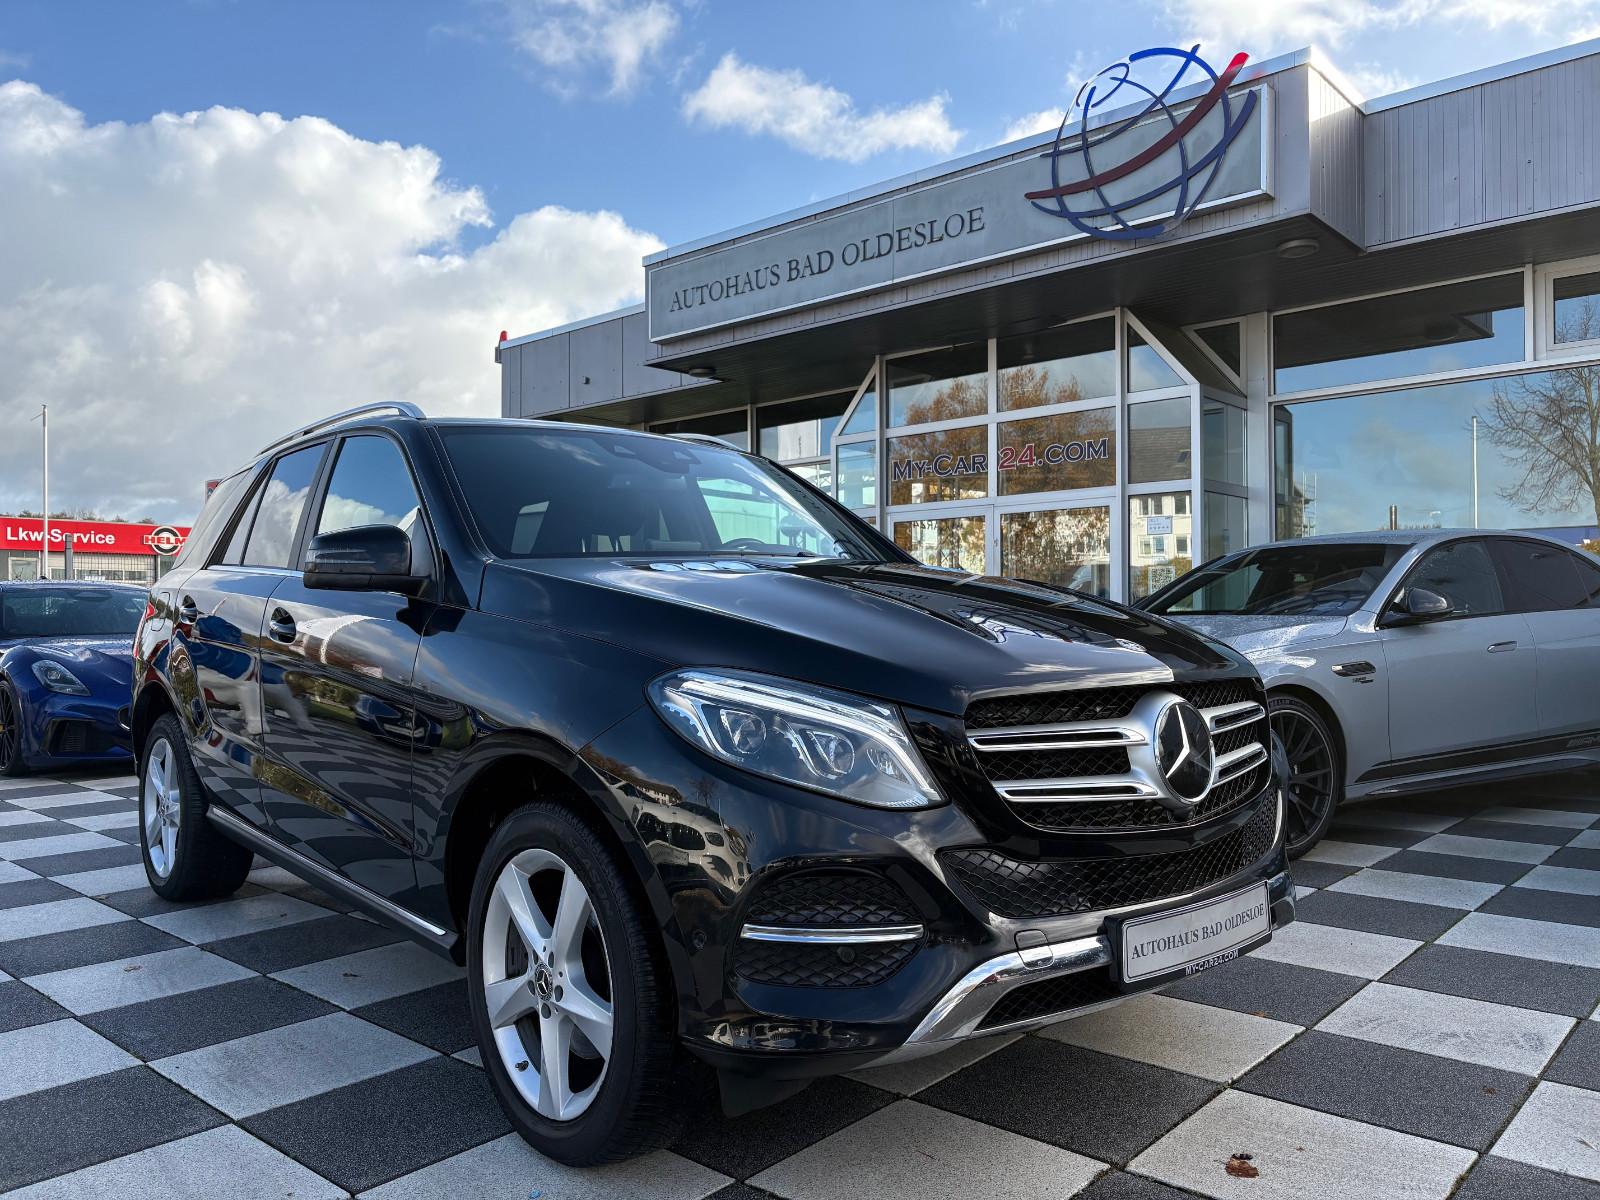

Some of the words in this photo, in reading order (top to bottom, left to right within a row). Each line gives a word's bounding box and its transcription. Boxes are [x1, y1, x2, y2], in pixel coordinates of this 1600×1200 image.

[669, 263, 780, 312] AUTOHAUS
[786, 249, 835, 282] BAD
[841, 206, 985, 267] OLDESLOE
[1131, 929, 1199, 960] AUTOHAUS
[1201, 923, 1223, 940] BAD
[1224, 903, 1265, 931] OLDESLOE
[1185, 949, 1240, 976] MY-CAR24.COM
